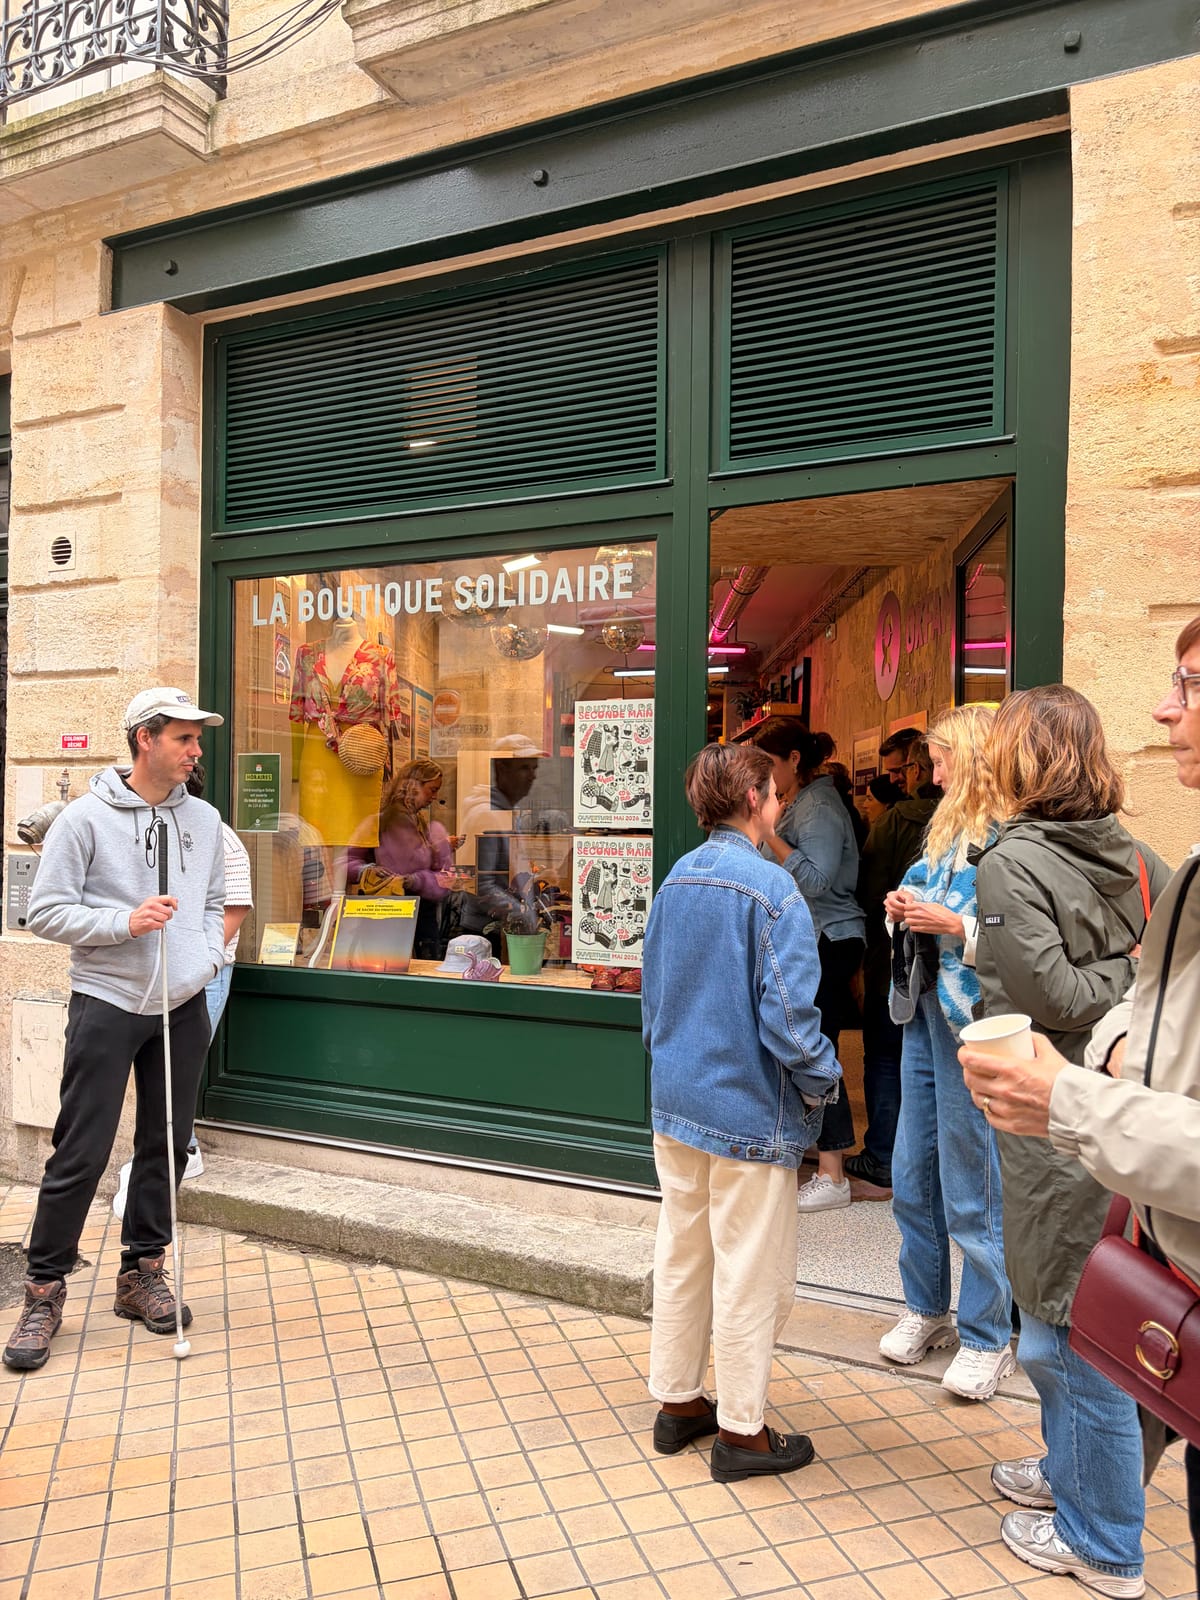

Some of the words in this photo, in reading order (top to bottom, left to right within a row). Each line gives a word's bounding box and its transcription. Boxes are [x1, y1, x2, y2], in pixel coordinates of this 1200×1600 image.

[252, 592, 287, 627] LA
[298, 577, 443, 622] BOUTIQUE
[454, 562, 634, 611] SOLIDAIRE
[578, 711, 625, 720] SECONDE
[628, 710, 653, 718] MAIN
[578, 848, 624, 856] SECONDE
[627, 848, 652, 856] MAIN
